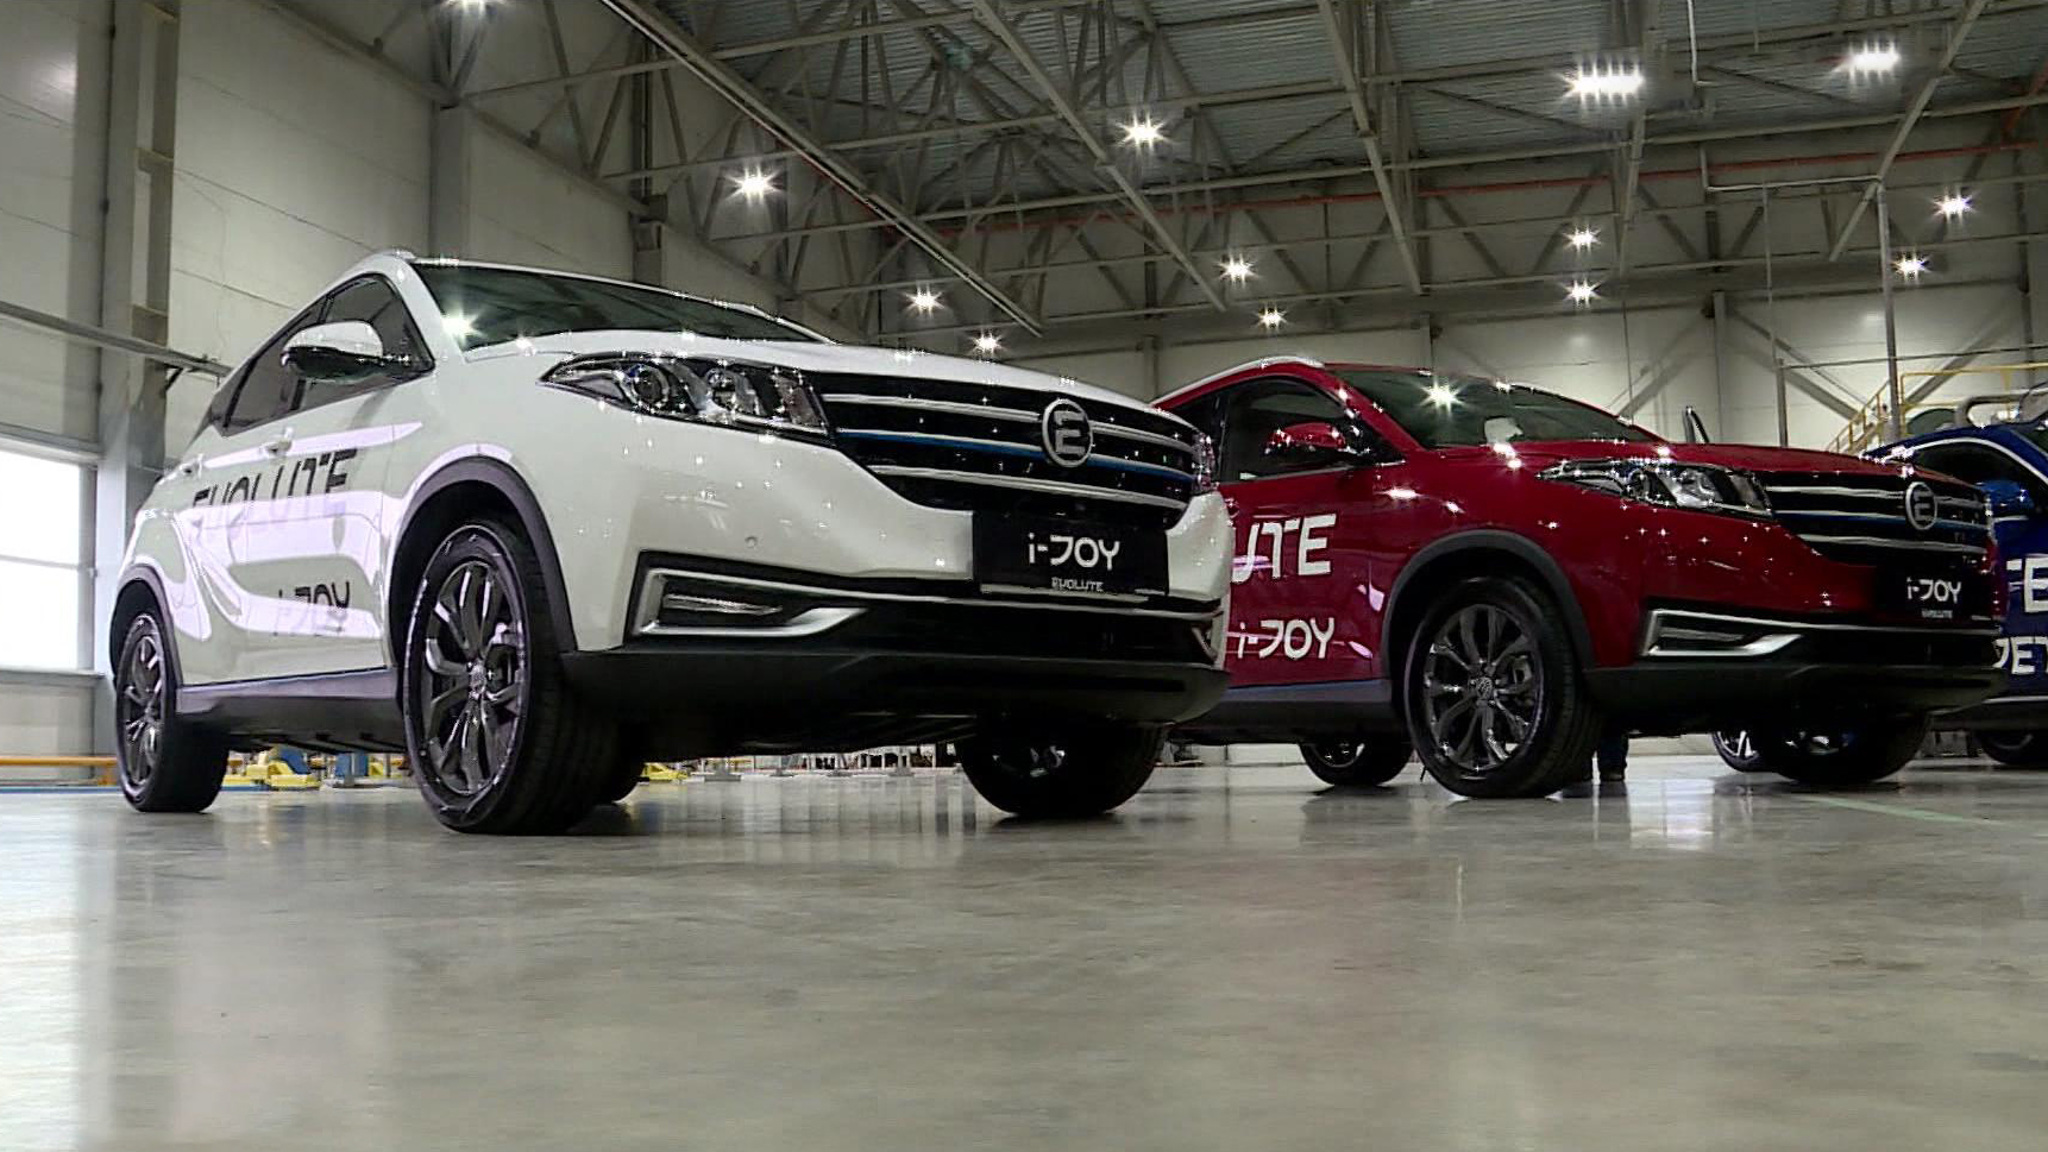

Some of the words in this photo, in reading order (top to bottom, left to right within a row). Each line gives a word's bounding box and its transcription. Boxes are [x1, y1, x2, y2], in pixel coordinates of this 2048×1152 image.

[1028, 532, 1120, 571] i-JOY
[1906, 576, 1962, 604] i-JOY
[1237, 617, 1336, 660] i-JOY
